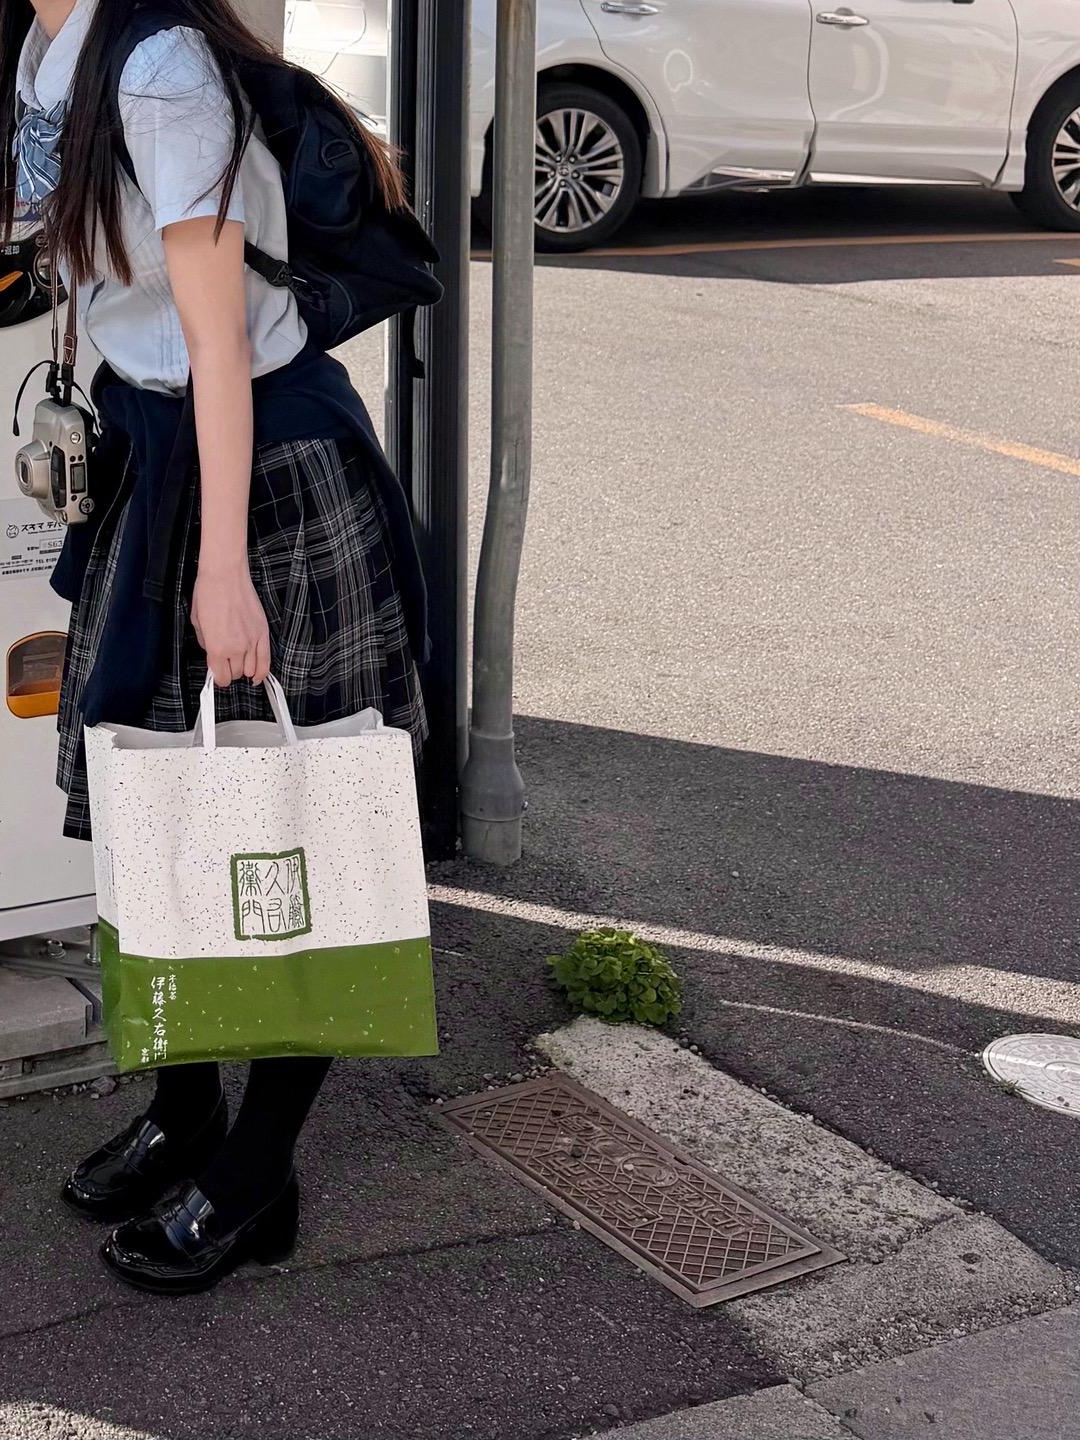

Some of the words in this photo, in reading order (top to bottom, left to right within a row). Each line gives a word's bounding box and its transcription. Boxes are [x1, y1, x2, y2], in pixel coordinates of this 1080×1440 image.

[21, 522, 45, 532] スキマ
[151, 976, 168, 1060] 伊藤久右衛門
